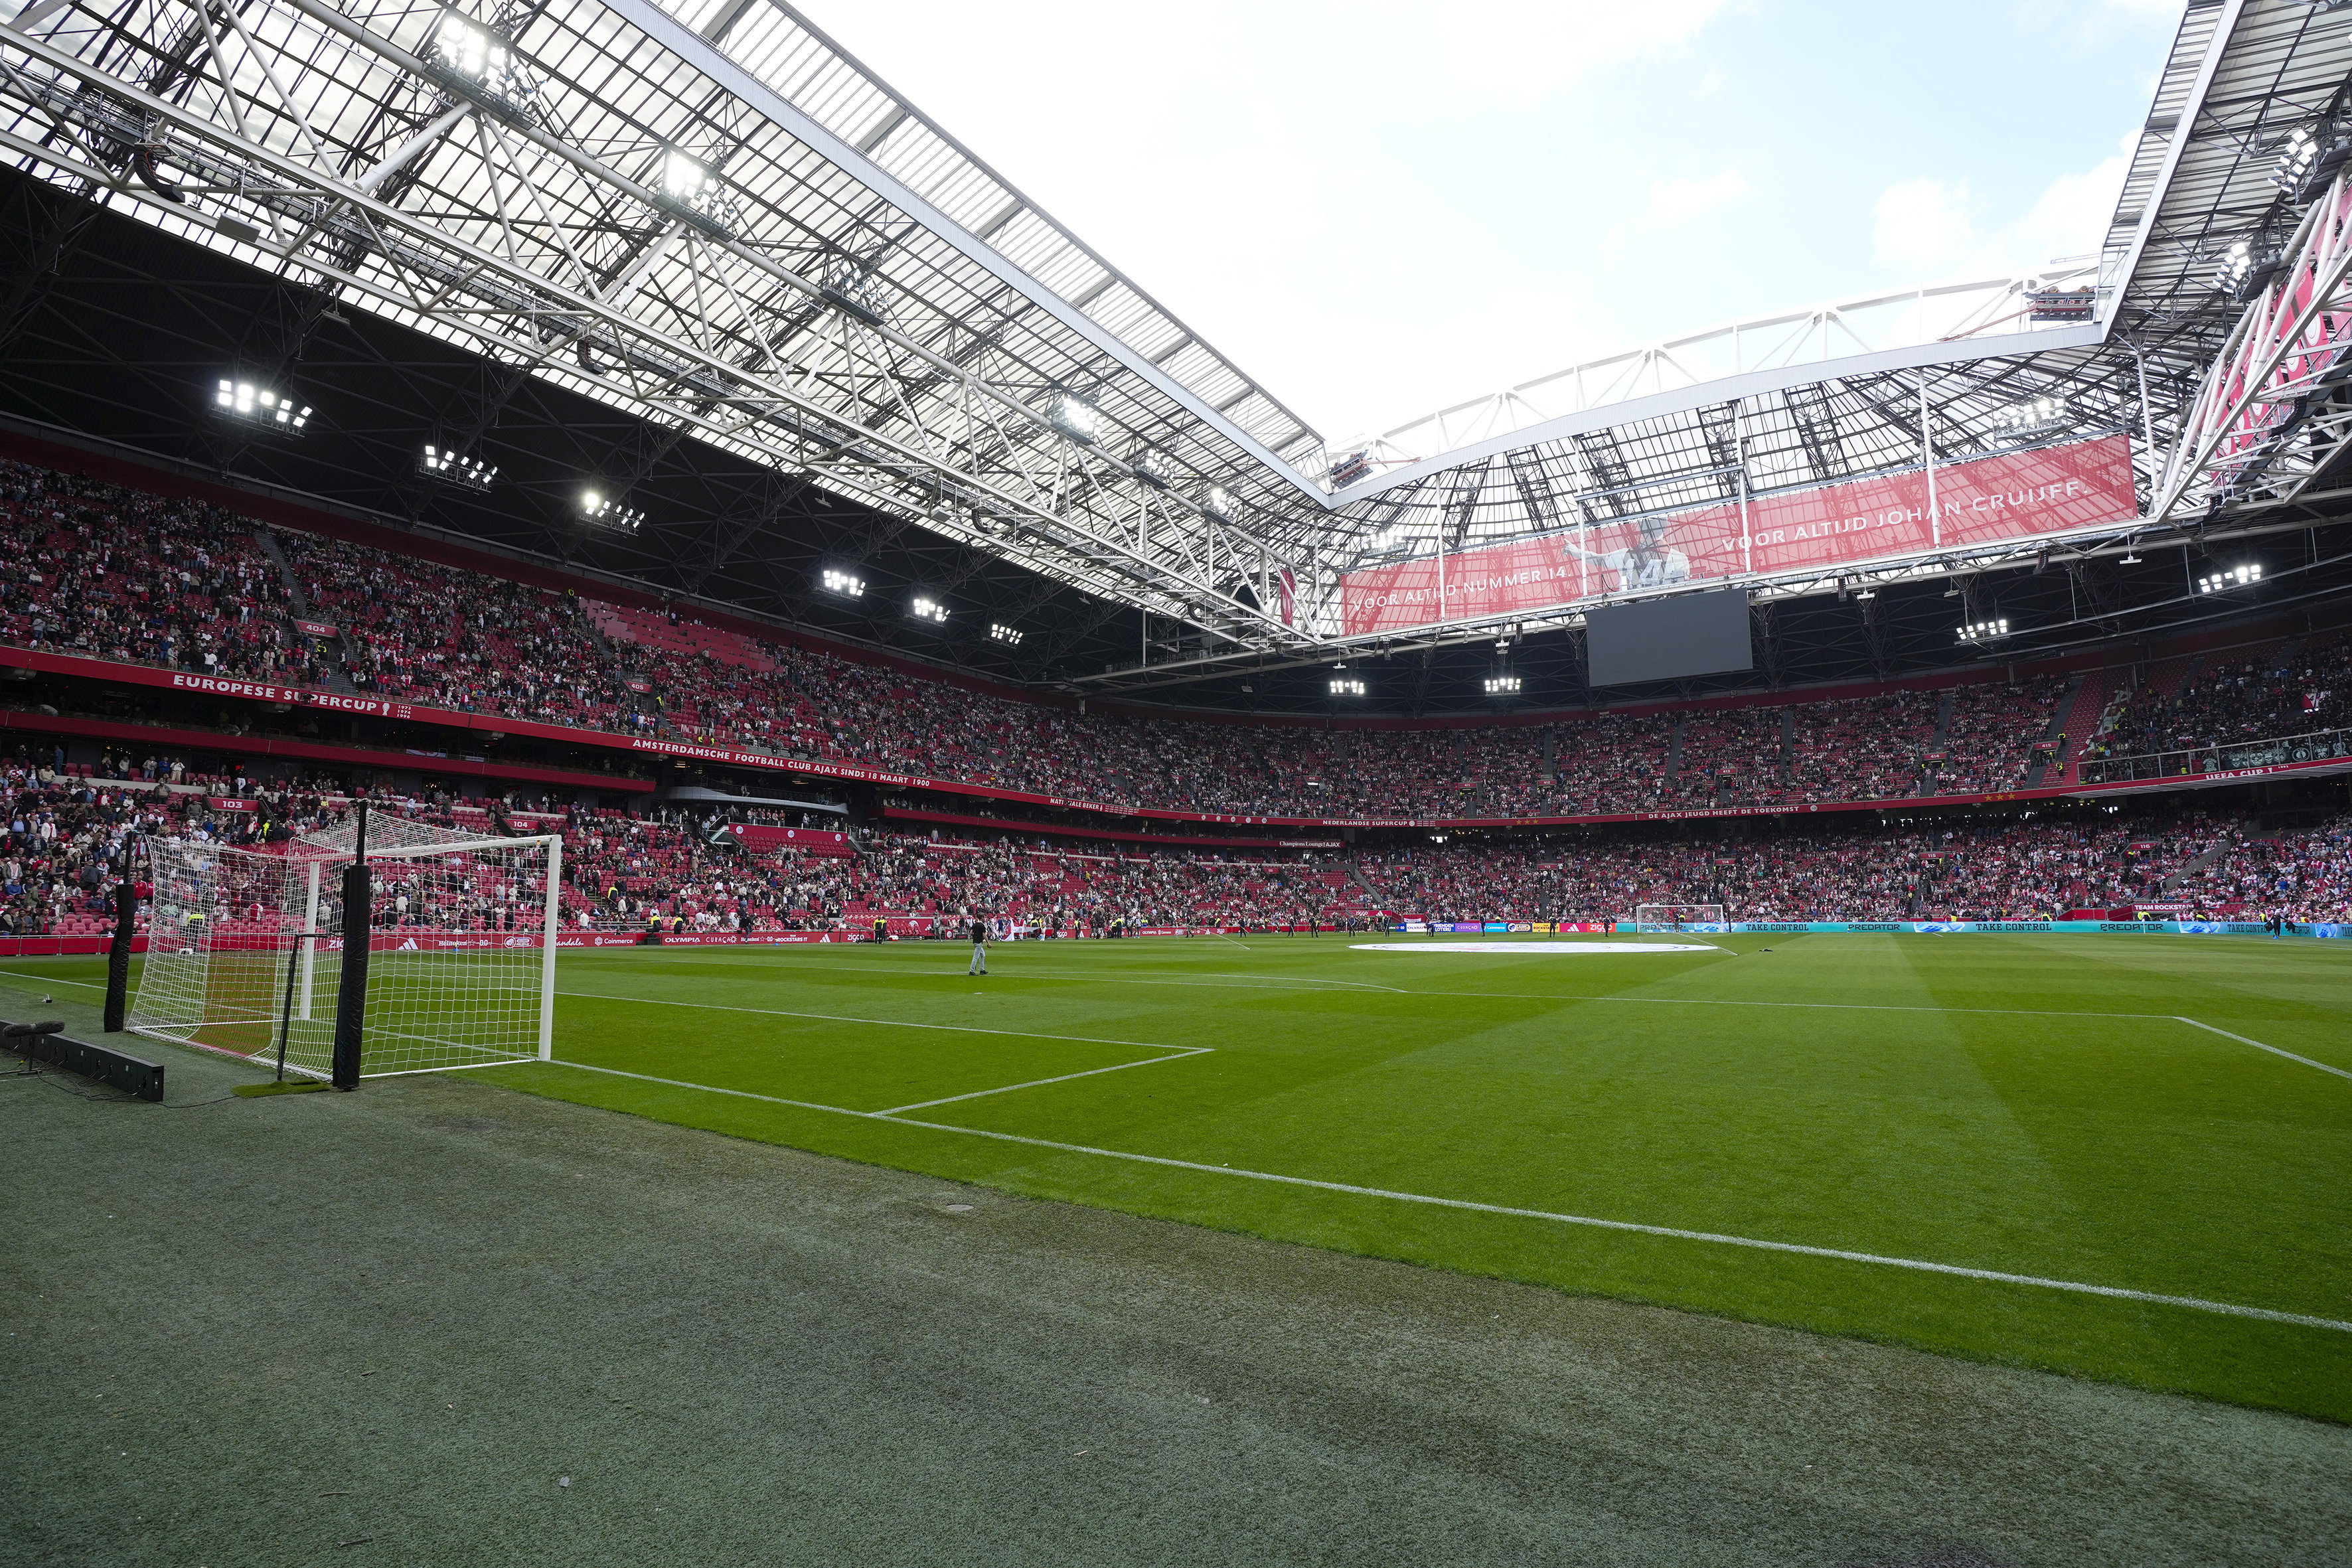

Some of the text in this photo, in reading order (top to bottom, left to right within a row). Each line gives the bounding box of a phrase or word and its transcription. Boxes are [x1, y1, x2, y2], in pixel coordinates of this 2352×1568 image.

[1721, 530, 1786, 551] VOOR
[1794, 516, 1867, 540] ALTIJD
[1972, 481, 2088, 511] CRUIJFF.
[1353, 593, 1398, 612] VOOR
[1404, 584, 1456, 603] ALTID
[1463, 570, 1541, 593] NUMMER
[306, 624, 325, 633] 404
[173, 674, 275, 698] EUROPESE
[633, 740, 730, 759] AMSTERDAMSCHE
[735, 753, 785, 767] FOOTBALL
[788, 761, 811, 770] CLUB
[814, 765, 837, 775] AJAX
[840, 769, 865, 778] SINDS
[880, 774, 908, 784] MAART
[913, 778, 929, 787] 1900
[2227, 924, 2245, 933] TAKE
[556, 937, 584, 947] andals
